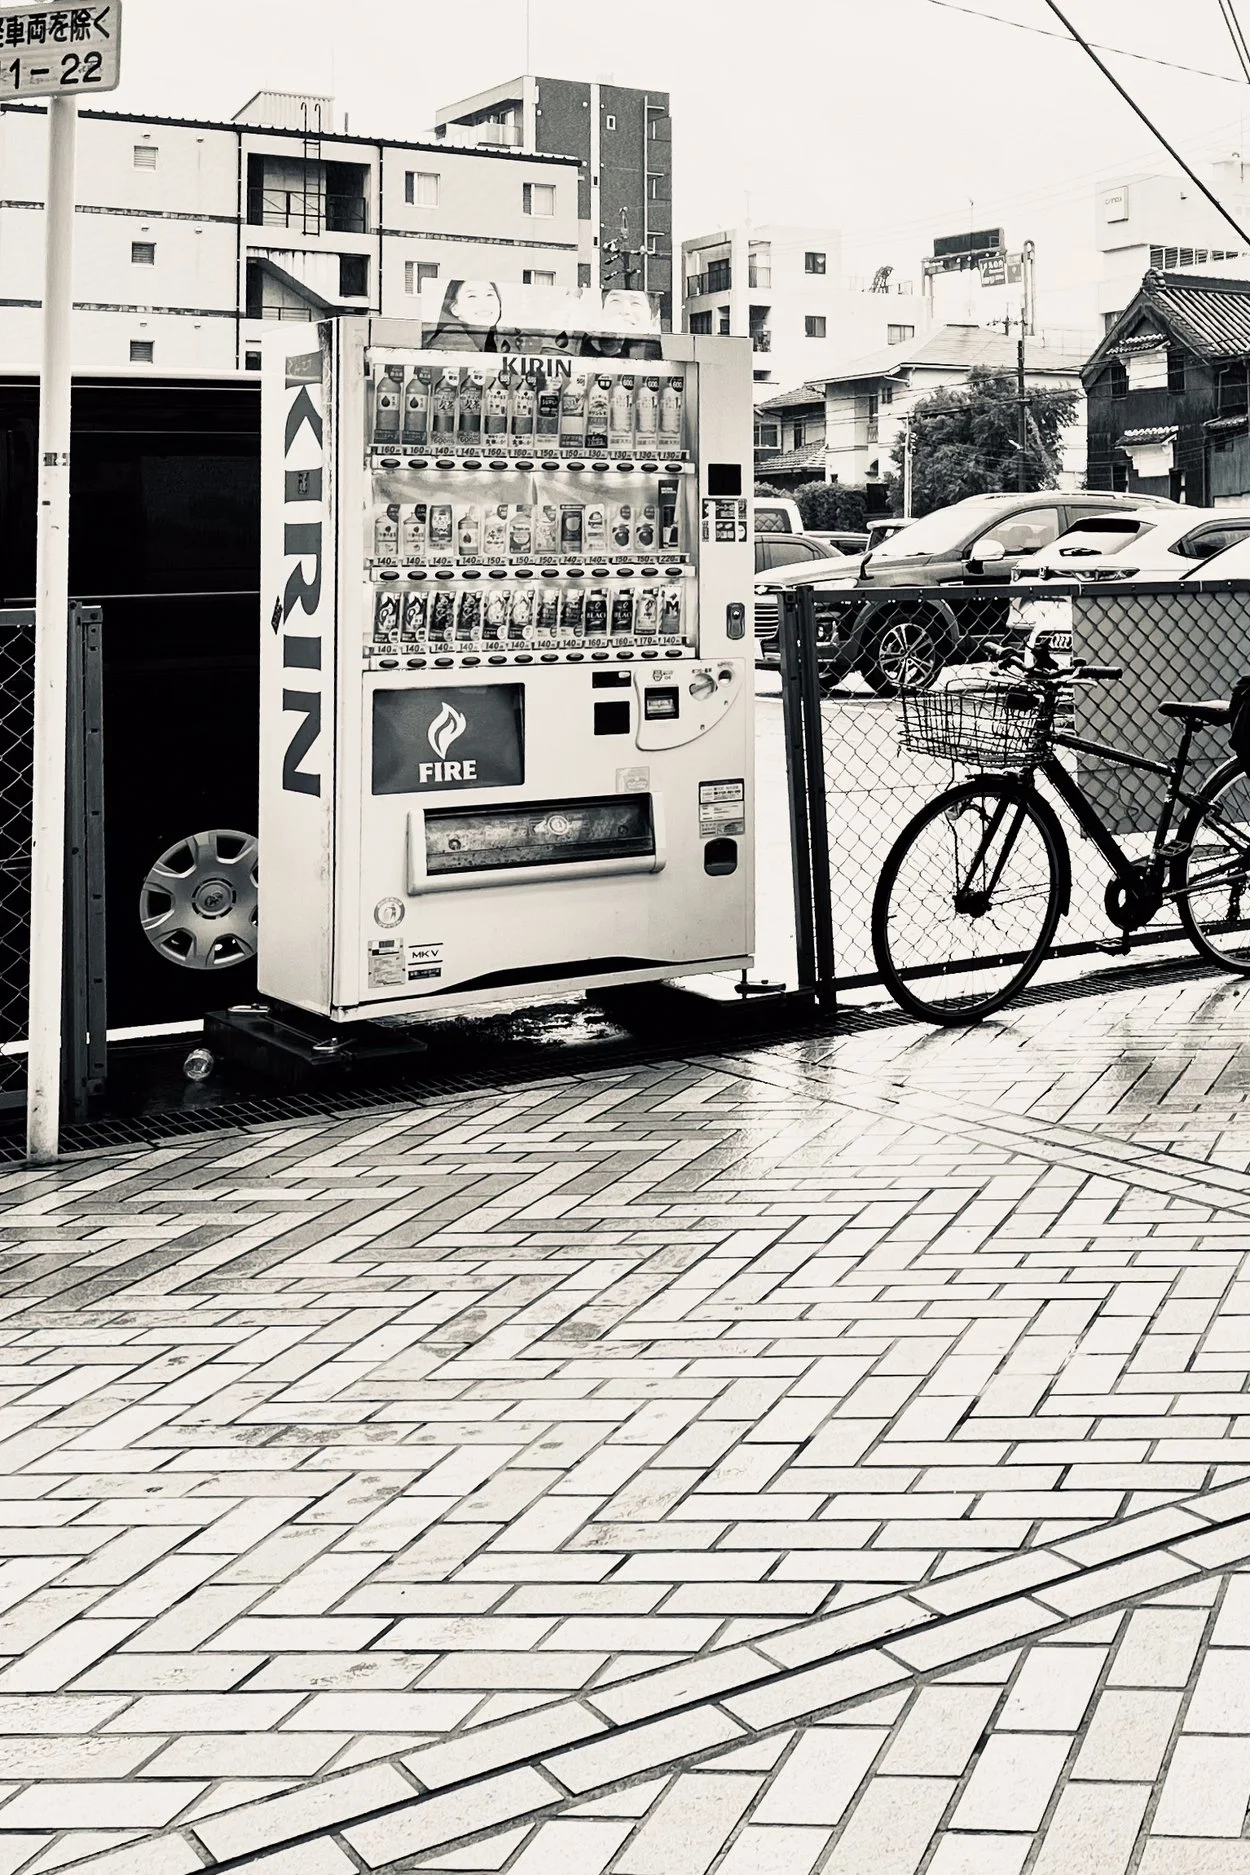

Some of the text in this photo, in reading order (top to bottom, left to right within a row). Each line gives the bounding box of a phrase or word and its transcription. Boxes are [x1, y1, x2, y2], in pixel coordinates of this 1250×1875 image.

[0, 6, 110, 47] 車両を除く
[502, 356, 572, 378] KIRIN
[282, 350, 324, 798] KIRIN
[419, 760, 478, 783] FIRE
